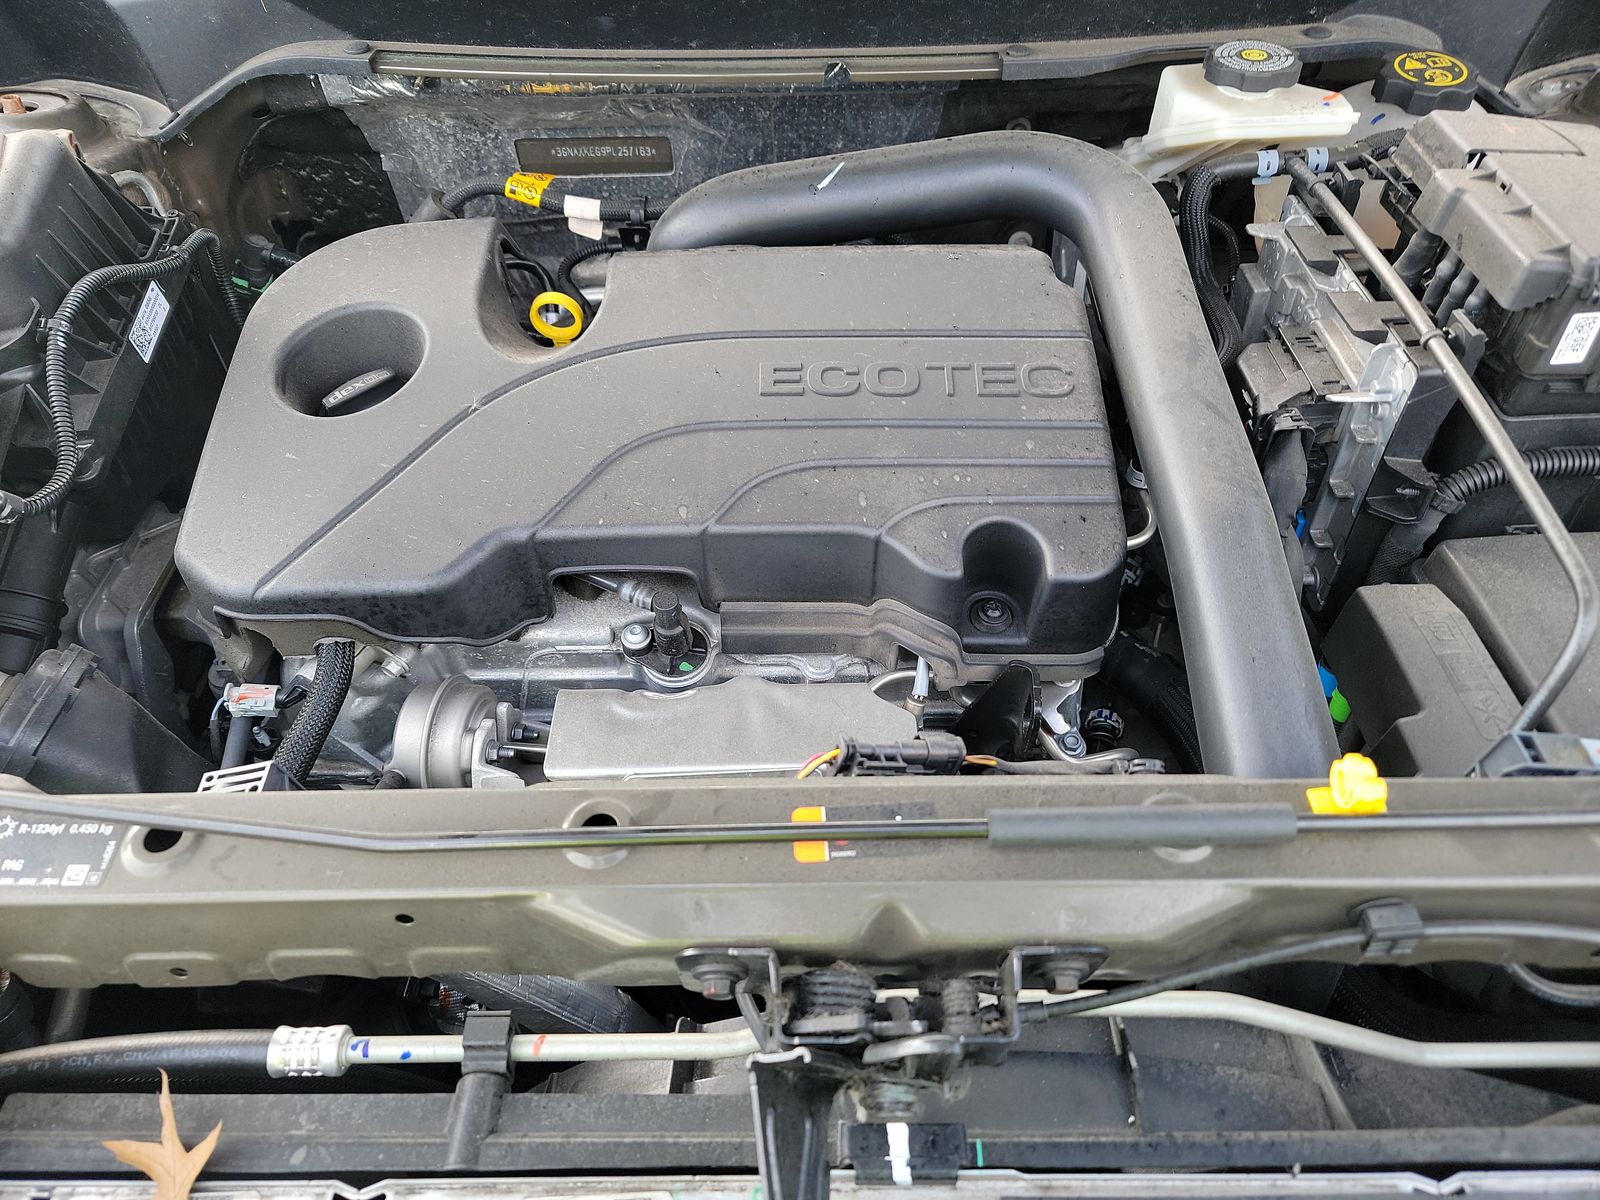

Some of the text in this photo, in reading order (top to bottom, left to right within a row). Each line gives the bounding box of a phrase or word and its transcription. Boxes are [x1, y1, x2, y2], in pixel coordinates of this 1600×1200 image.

[759, 361, 1076, 398] ECOTEC
[18, 823, 67, 837] R-1234yf
[99, 823, 114, 836] kg
